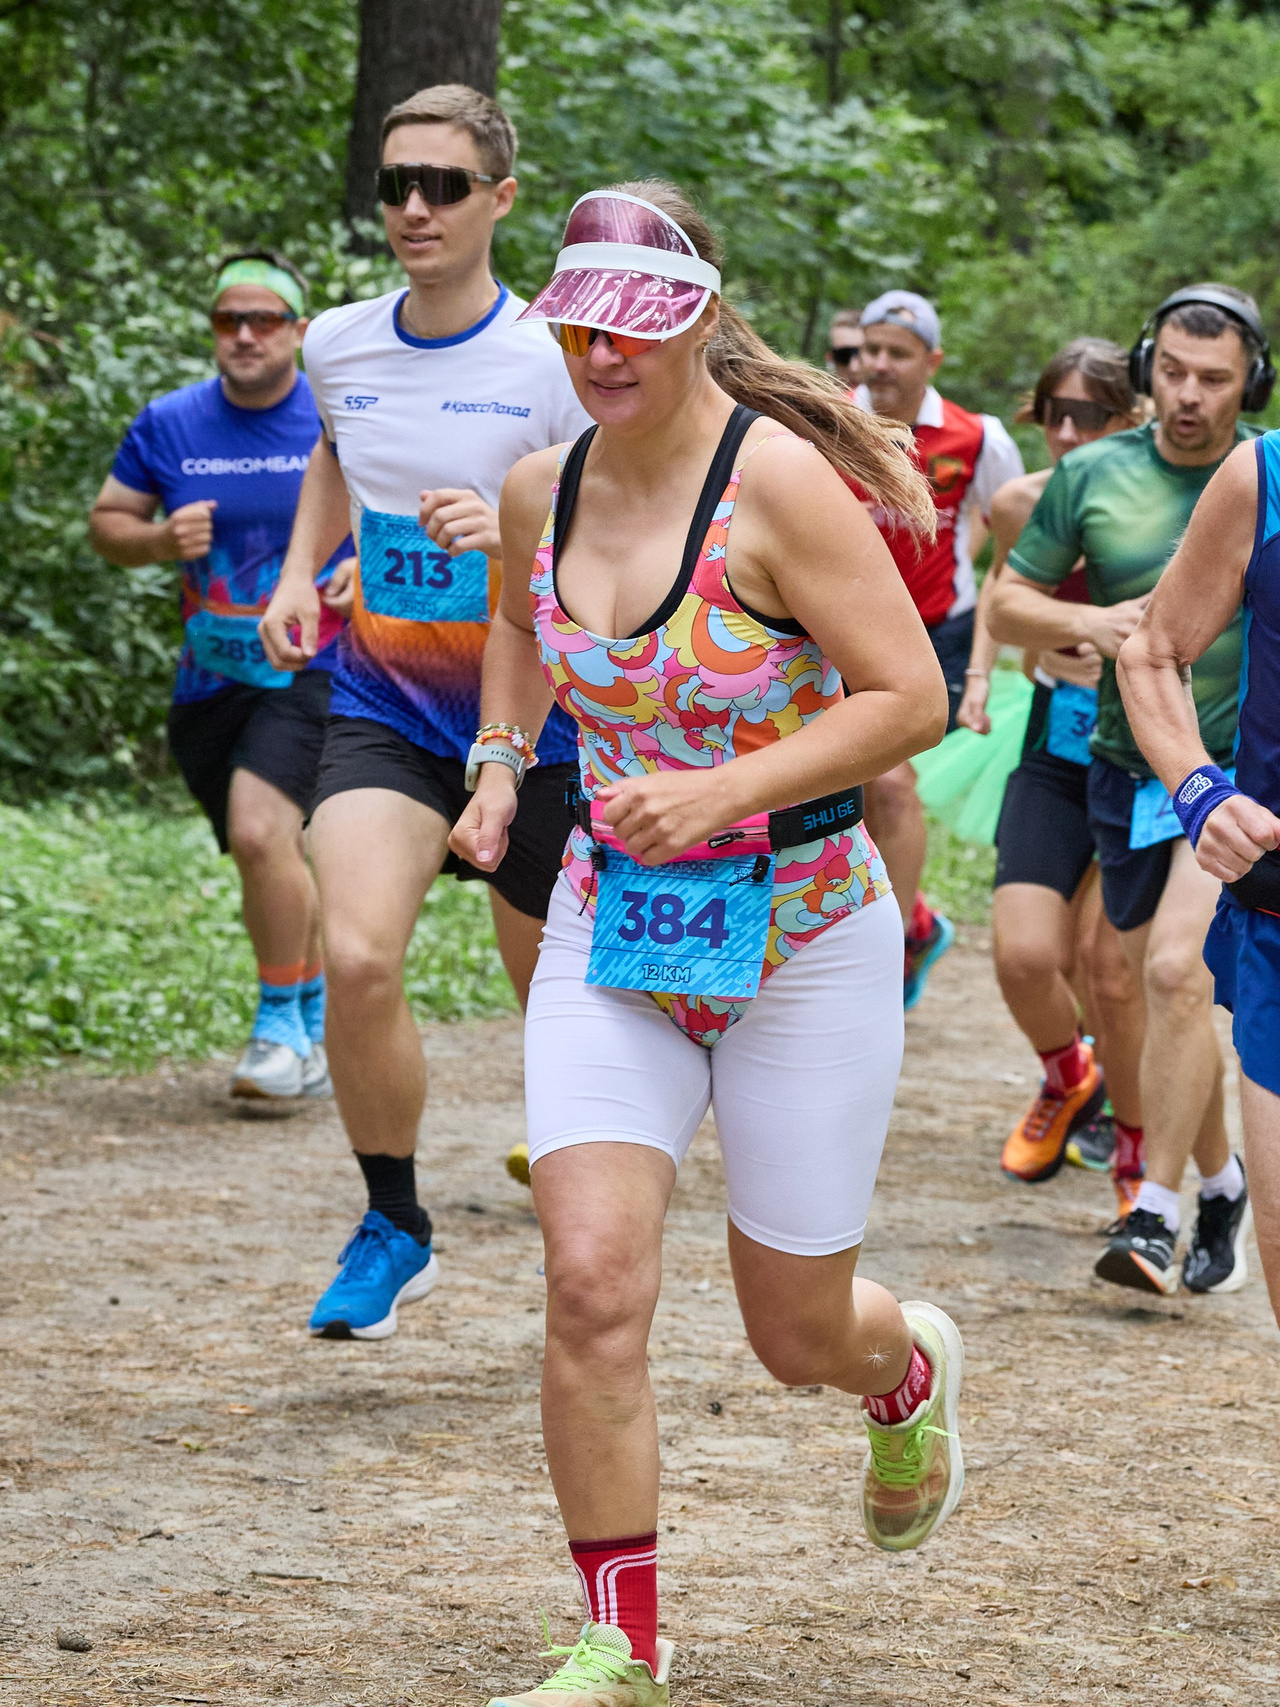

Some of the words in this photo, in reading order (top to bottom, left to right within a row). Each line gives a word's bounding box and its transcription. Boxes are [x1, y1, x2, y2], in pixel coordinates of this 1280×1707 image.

[384, 548, 453, 589] 213
[207, 635, 266, 664] 289
[617, 890, 729, 949] 384
[642, 964, 658, 979] 12
[662, 965, 690, 983] KM
